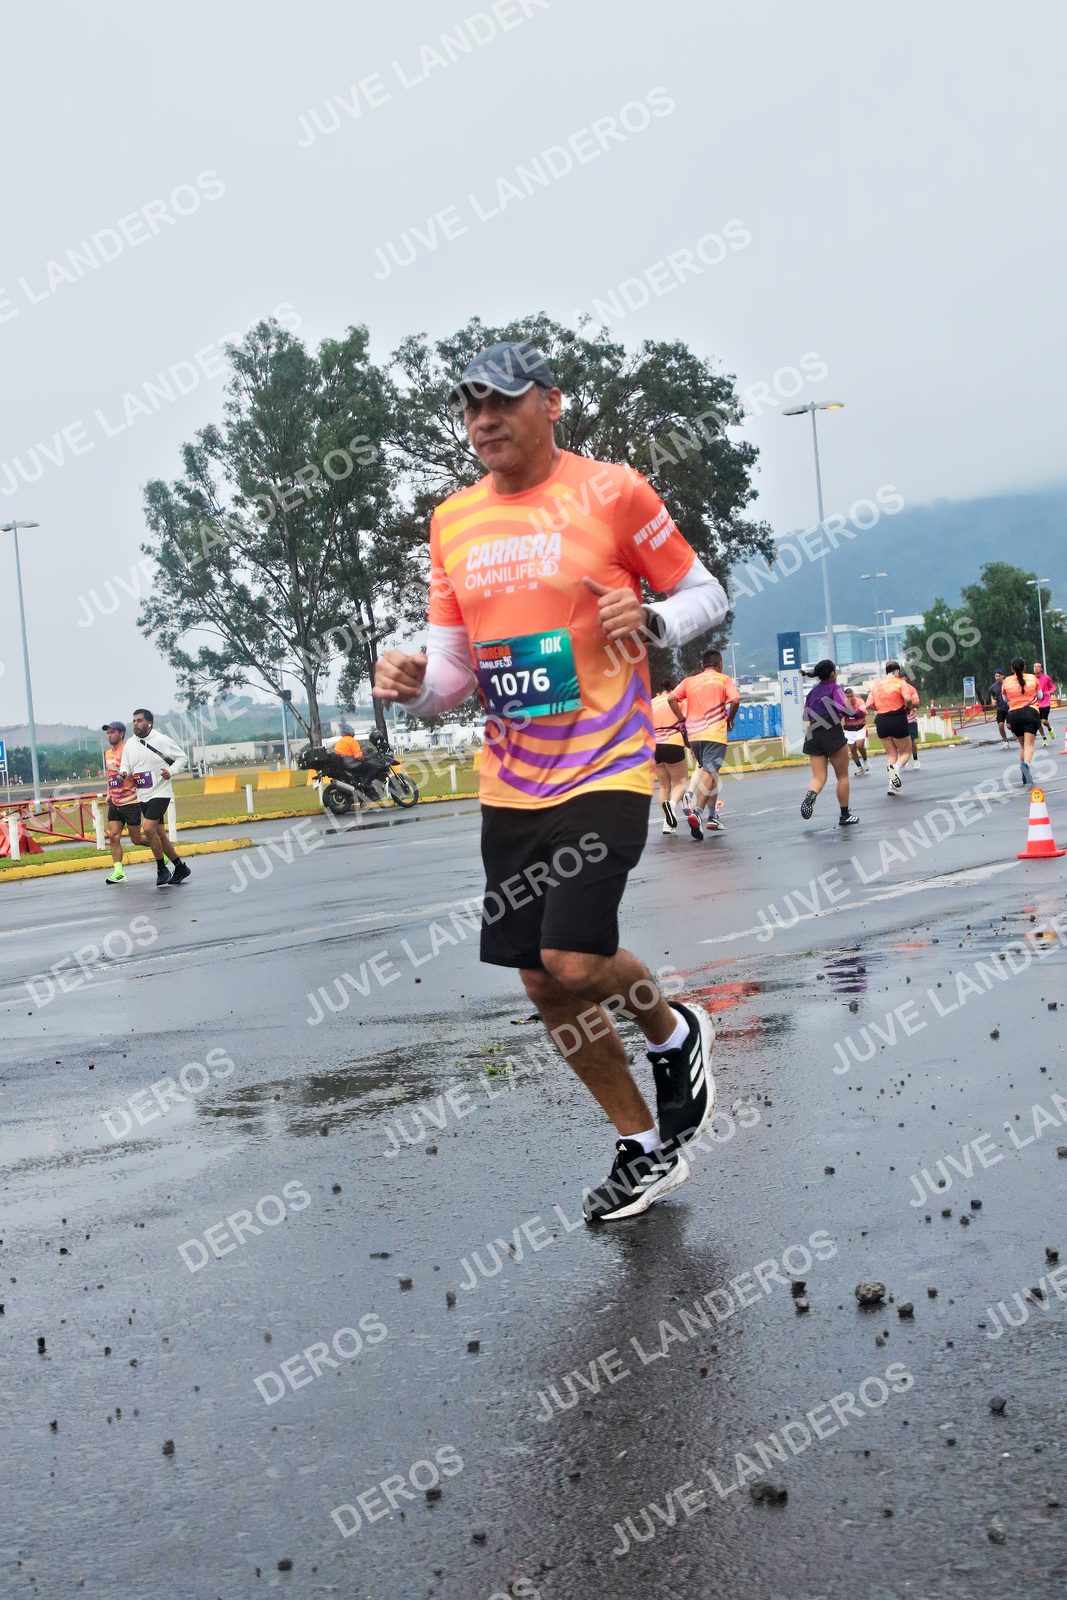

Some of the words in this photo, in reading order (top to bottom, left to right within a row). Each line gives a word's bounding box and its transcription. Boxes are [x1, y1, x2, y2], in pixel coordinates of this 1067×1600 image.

[466, 532, 561, 571] CARRERA
[464, 562, 536, 590] OMNILIFE
[540, 636, 562, 655] 10K
[782, 648, 796, 665] E
[490, 667, 551, 697] 1076
[792, 676, 800, 705] General
